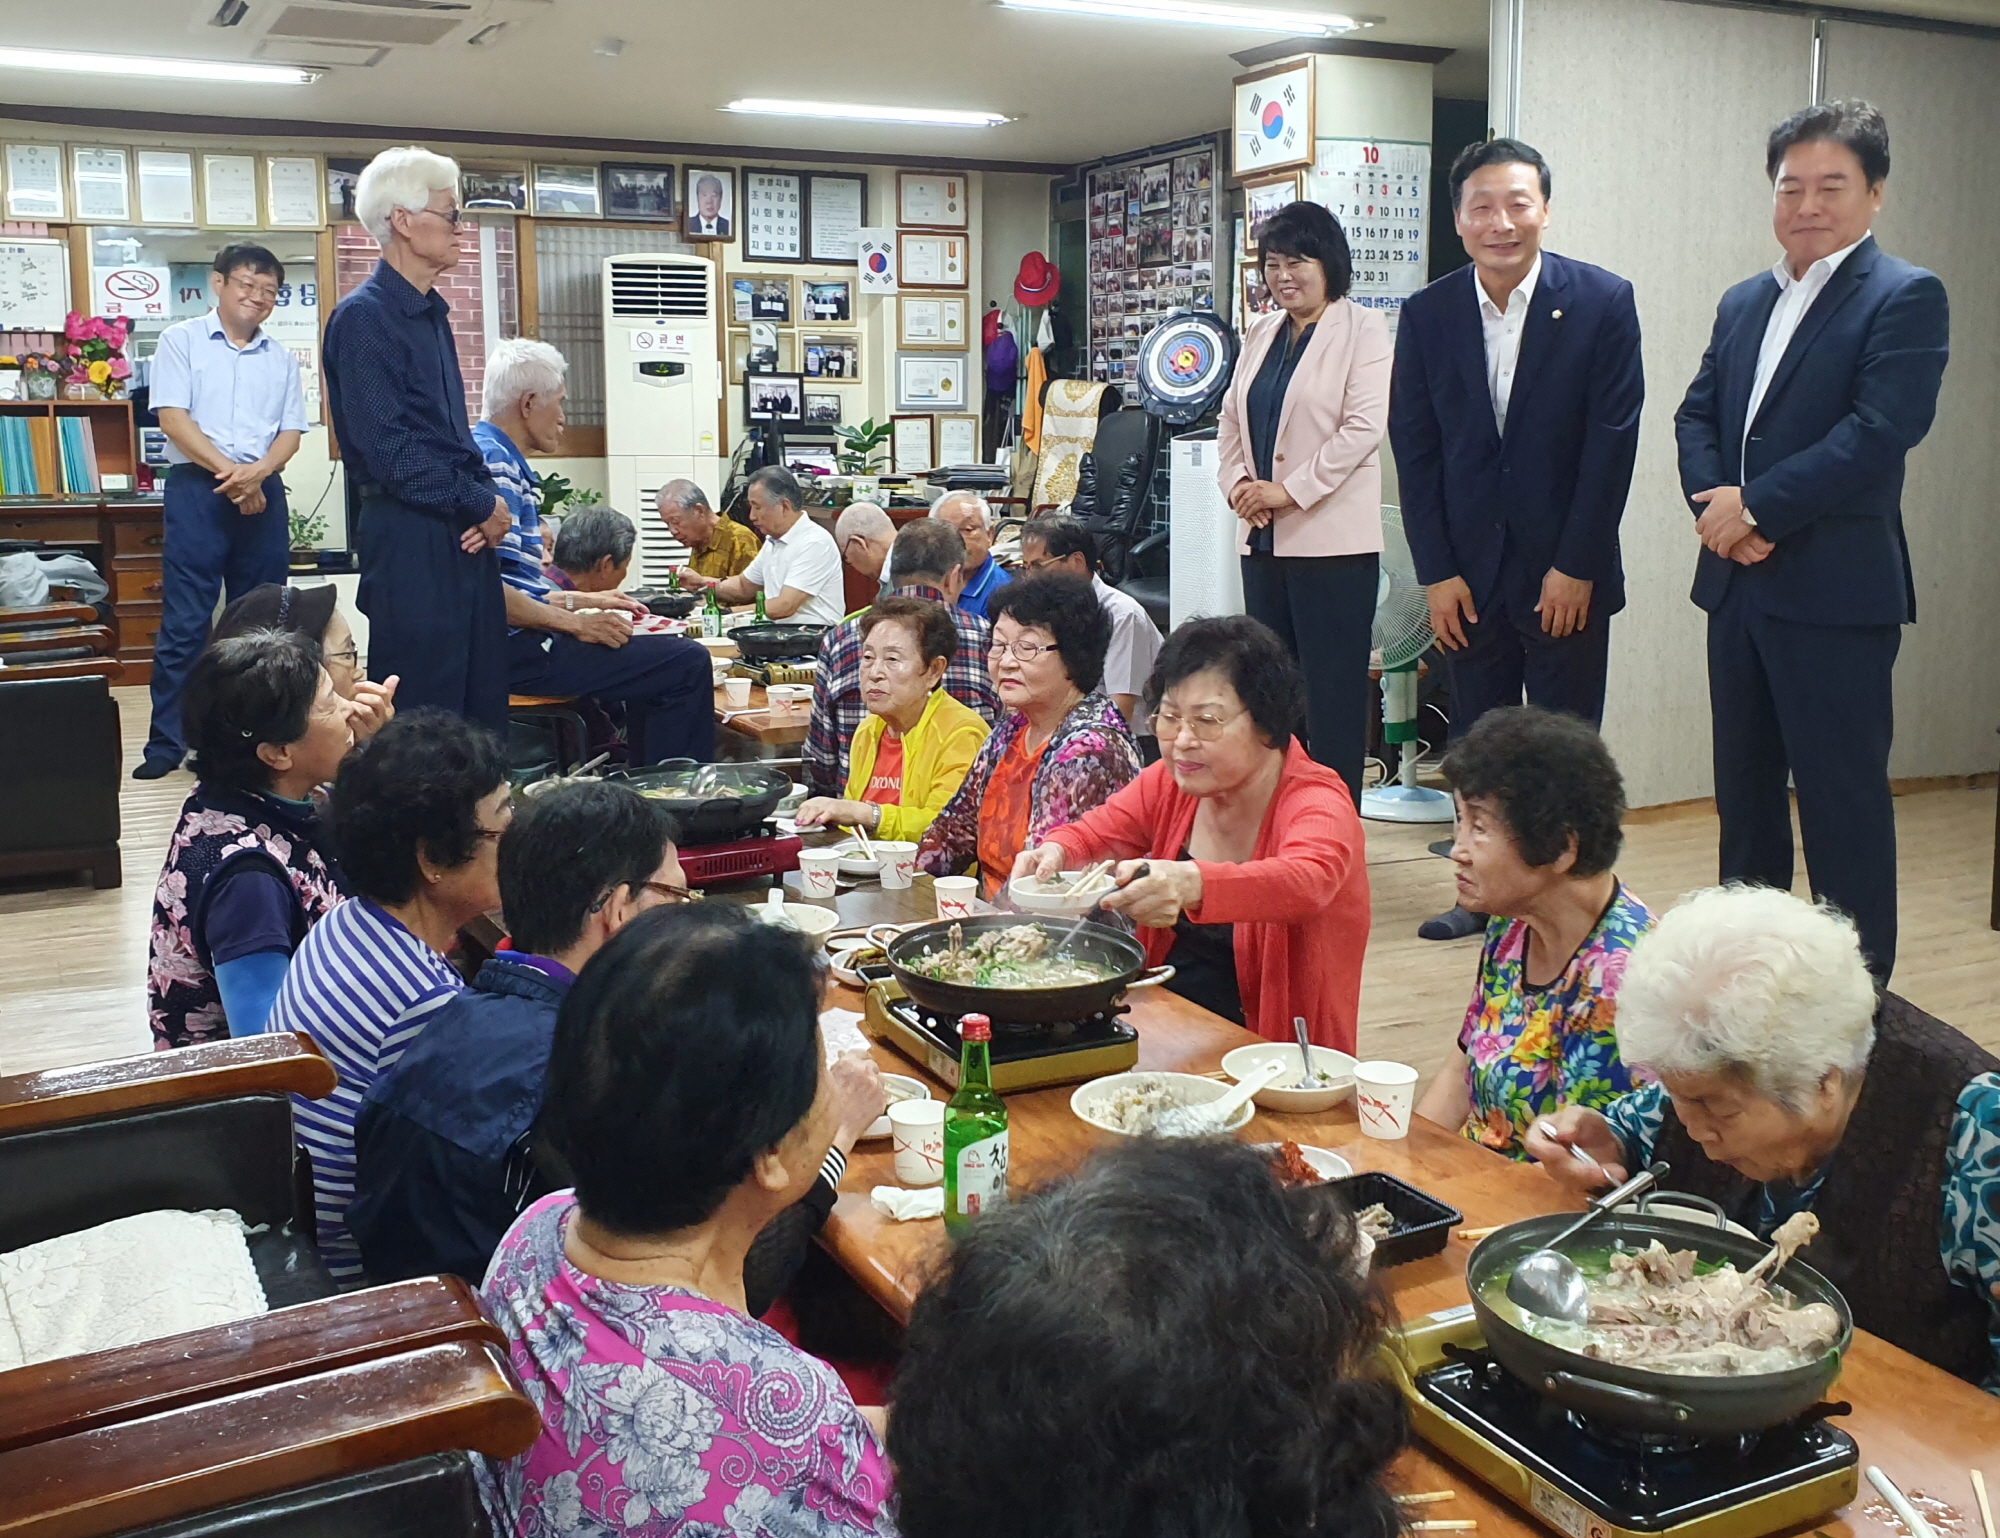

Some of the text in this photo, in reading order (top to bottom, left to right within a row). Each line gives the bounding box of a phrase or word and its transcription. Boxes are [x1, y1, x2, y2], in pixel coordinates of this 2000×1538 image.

[1363, 146, 1379, 164] 10
[1369, 184, 1374, 195] 2
[1382, 184, 1388, 196] 3
[1396, 186, 1402, 196] 4
[1411, 186, 1418, 197] 5
[1340, 204, 1345, 215] 7
[1354, 205, 1360, 215] 8
[1367, 205, 1374, 215] 9
[1380, 207, 1389, 216] 10
[1394, 208, 1404, 217] 11
[1409, 208, 1420, 218] 12
[1351, 227, 1361, 237] 15
[1365, 227, 1375, 238] 16
[1379, 228, 1389, 238] 17
[1393, 229, 1404, 239] 18
[1408, 230, 1419, 239] 19
[1351, 249, 1419, 261] 22 23 24 25 26
[1363, 271, 1375, 281] 30
[1378, 272, 1389, 281] 31
